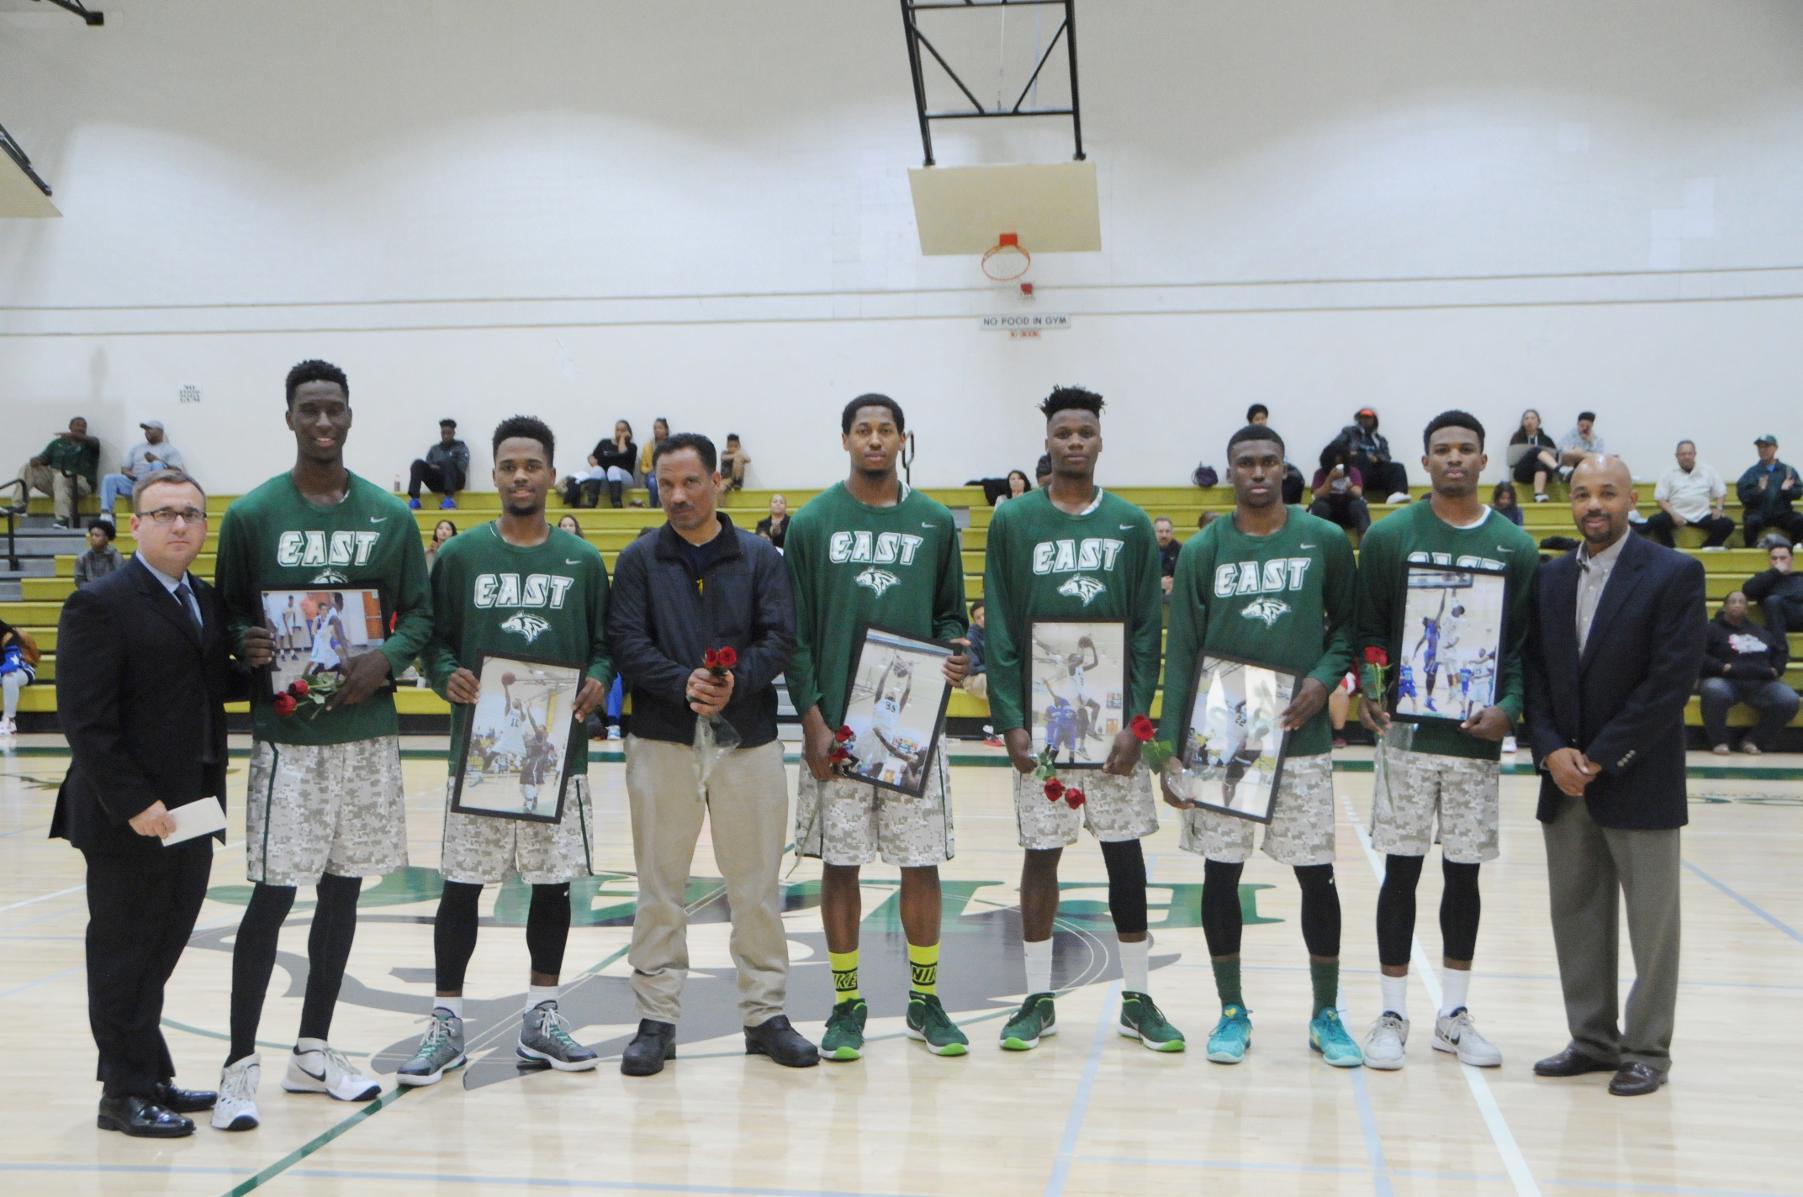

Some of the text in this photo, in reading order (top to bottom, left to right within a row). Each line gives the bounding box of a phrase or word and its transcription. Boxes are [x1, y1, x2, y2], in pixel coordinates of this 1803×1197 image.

[983, 315, 1067, 326] NO FOOD IN GYM
[277, 530, 381, 567] EAST
[829, 530, 924, 566] EAST
[1033, 538, 1125, 575] EAST
[474, 573, 575, 609] EAST
[1214, 557, 1312, 598] EAST
